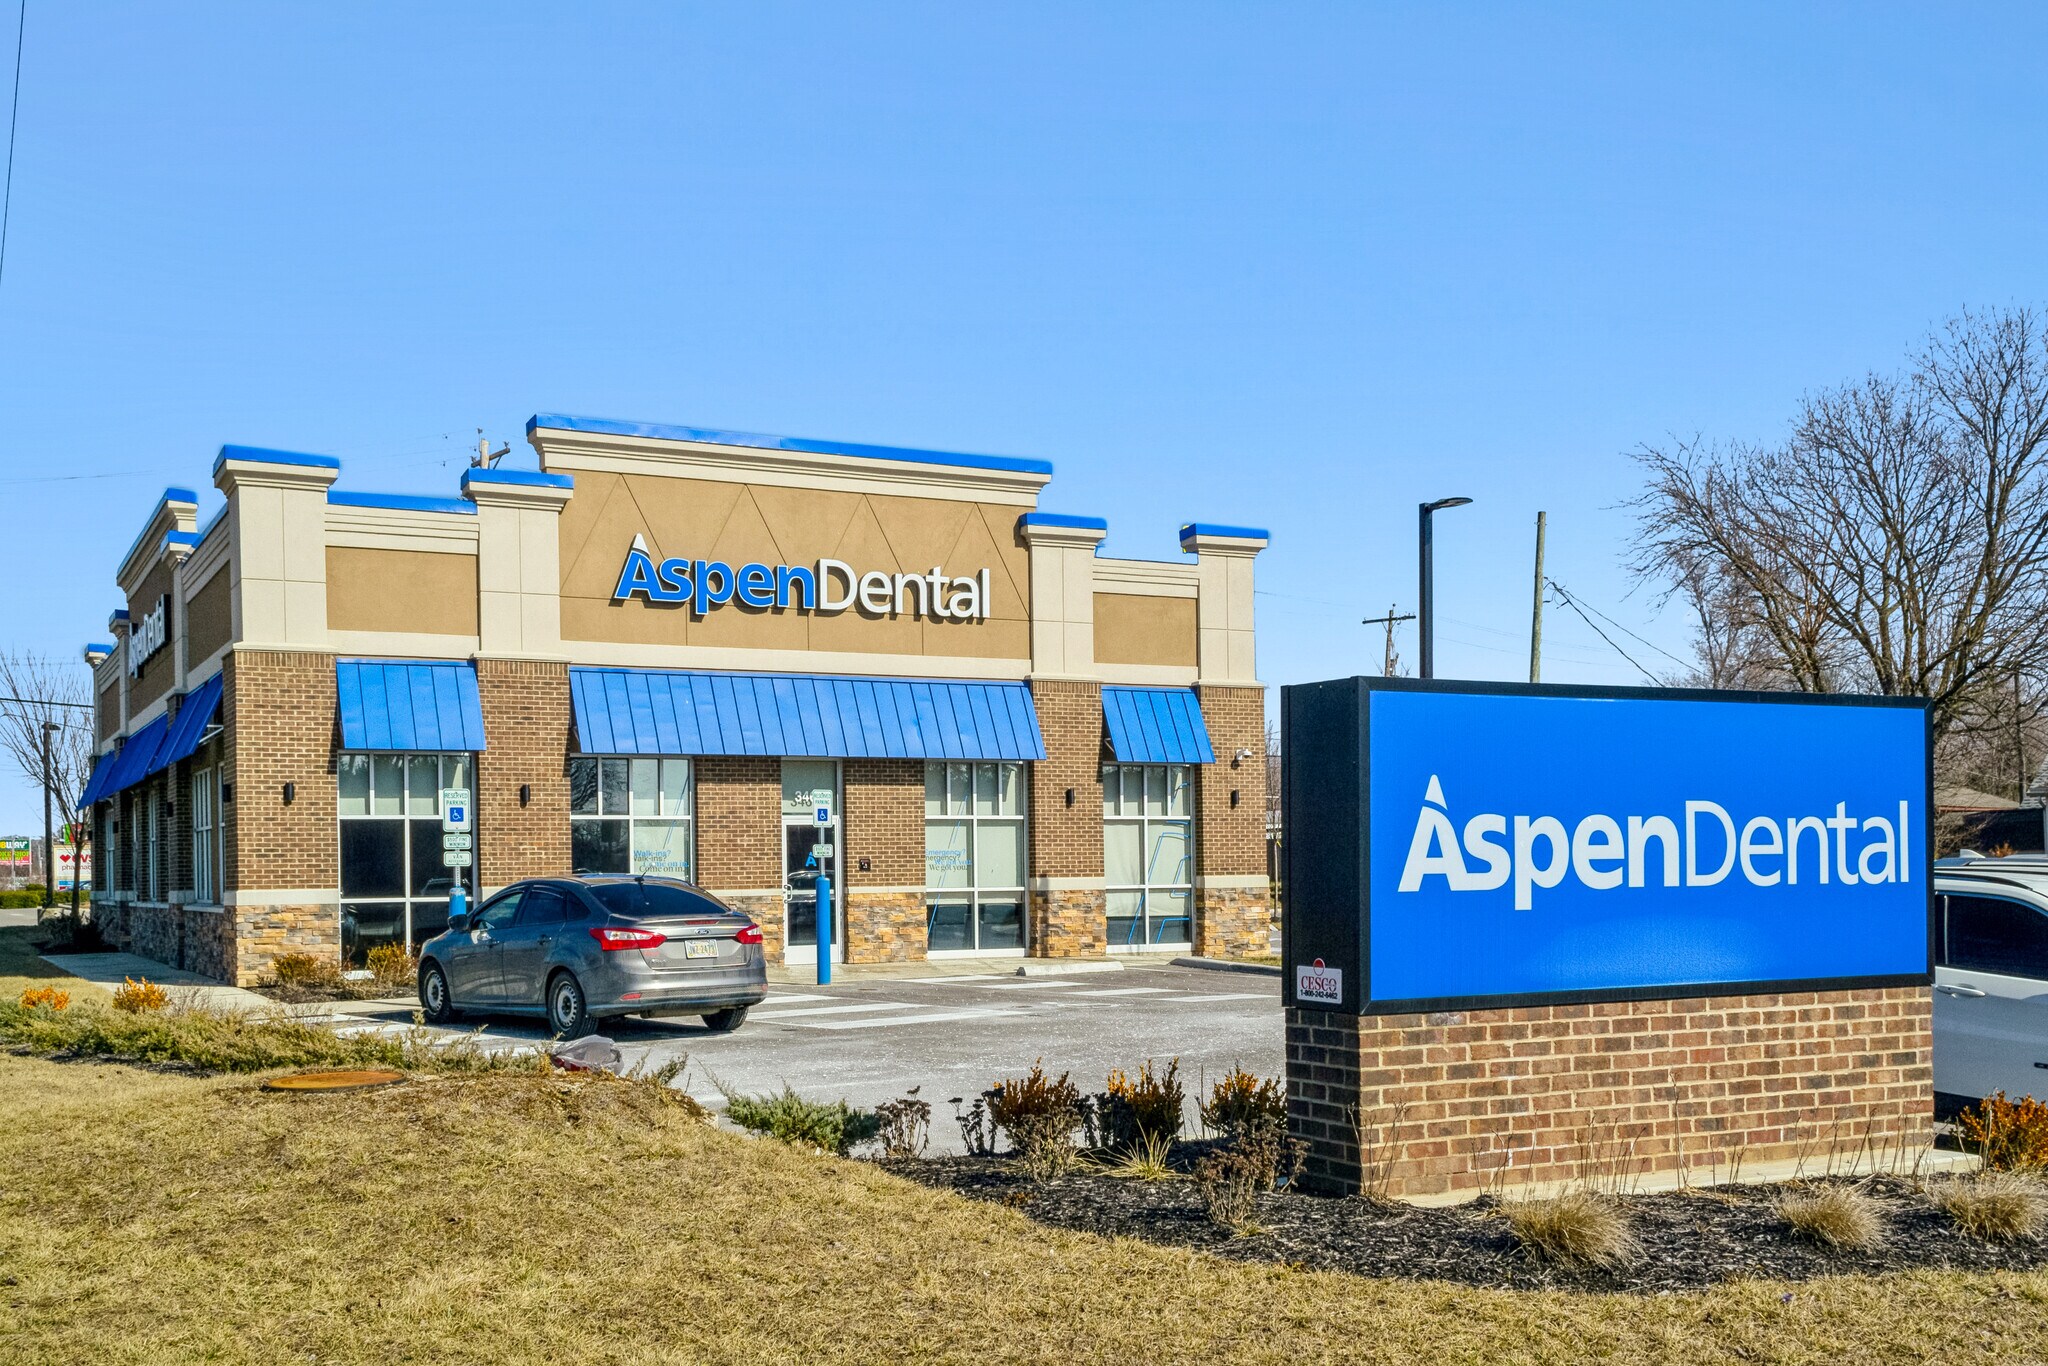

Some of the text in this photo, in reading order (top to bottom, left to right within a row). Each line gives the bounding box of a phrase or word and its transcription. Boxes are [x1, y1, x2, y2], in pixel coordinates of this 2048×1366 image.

[614, 532, 990, 618] AspenDental
[1397, 774, 1909, 910] AspenDental
[1301, 976, 1337, 992] CESCO
